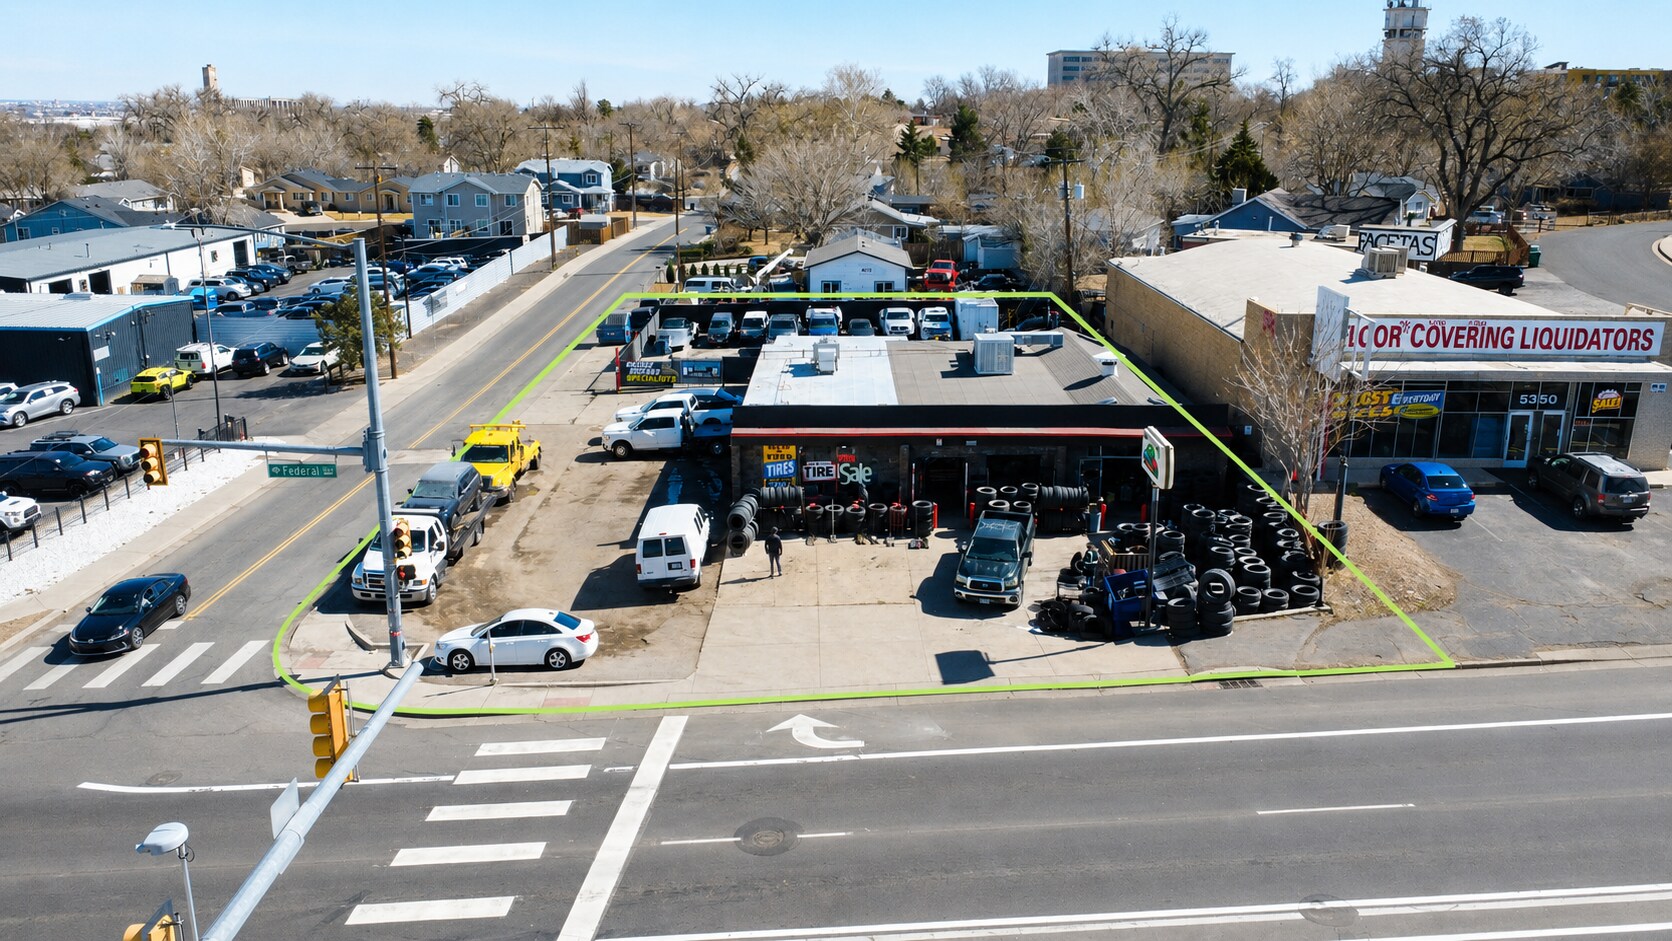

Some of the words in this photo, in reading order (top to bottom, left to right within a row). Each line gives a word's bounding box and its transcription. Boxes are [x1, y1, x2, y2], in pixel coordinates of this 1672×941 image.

[1347, 324, 1401, 348] LOOR
[1410, 323, 1515, 349] COVERING
[1520, 326, 1655, 351] LIQUIDATORS
[1519, 394, 1558, 405] 5350
[282, 465, 320, 476] Federal
[766, 460, 795, 477] TIRES
[804, 466, 834, 478] TIRE
[839, 462, 873, 485] Sale
